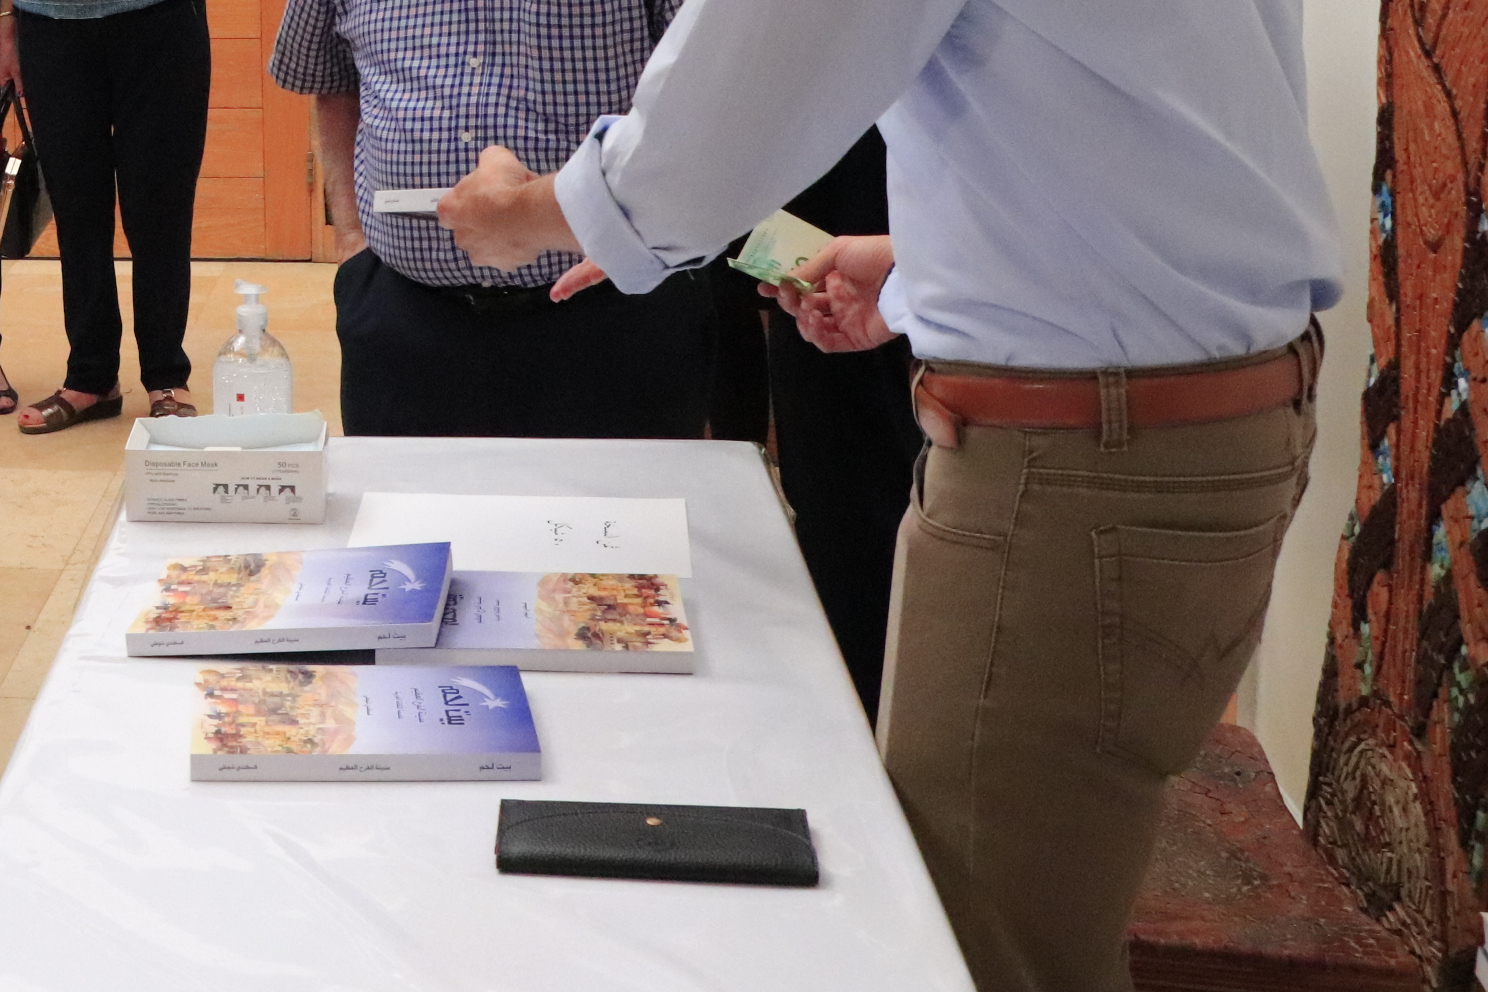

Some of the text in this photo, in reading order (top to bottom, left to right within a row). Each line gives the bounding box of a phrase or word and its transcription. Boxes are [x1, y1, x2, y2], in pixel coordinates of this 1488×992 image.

[144, 459, 182, 469] Disposable
[182, 460, 199, 468] Face
[356, 569, 389, 606] بيت لحم
[377, 632, 406, 642] بيت لحم
[438, 685, 472, 725] بيت لحم
[479, 762, 511, 772] بيت لحم
